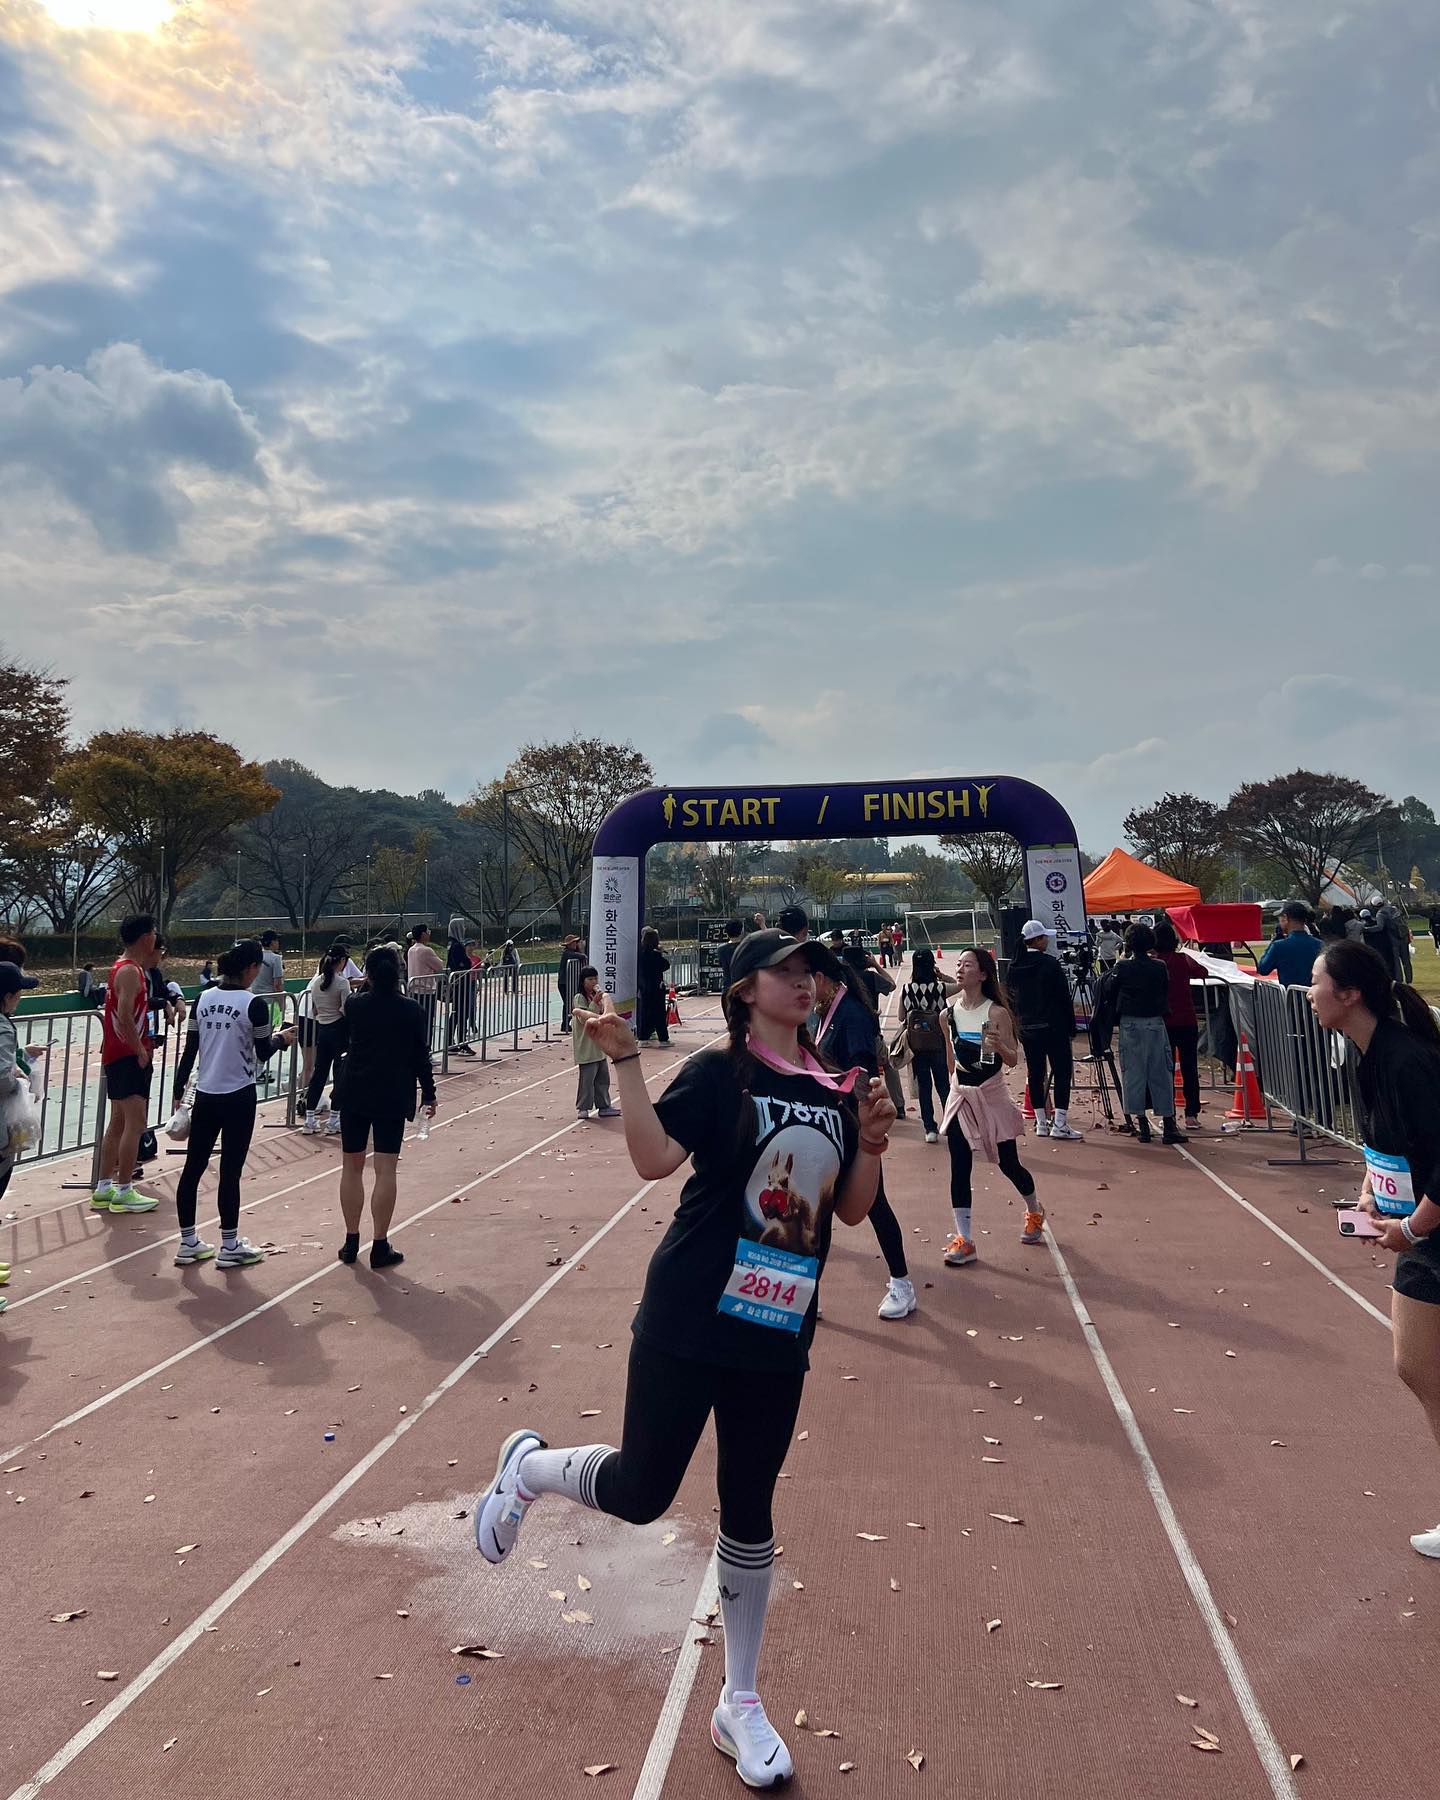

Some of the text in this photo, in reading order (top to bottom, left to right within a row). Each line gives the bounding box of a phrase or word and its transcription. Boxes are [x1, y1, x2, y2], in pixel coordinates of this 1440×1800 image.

[682, 789, 970, 826] START / FINISH
[604, 908, 618, 994] 화순군체육회
[200, 1004, 241, 1020] 나주마라톤
[738, 1271, 797, 1306] 2814
